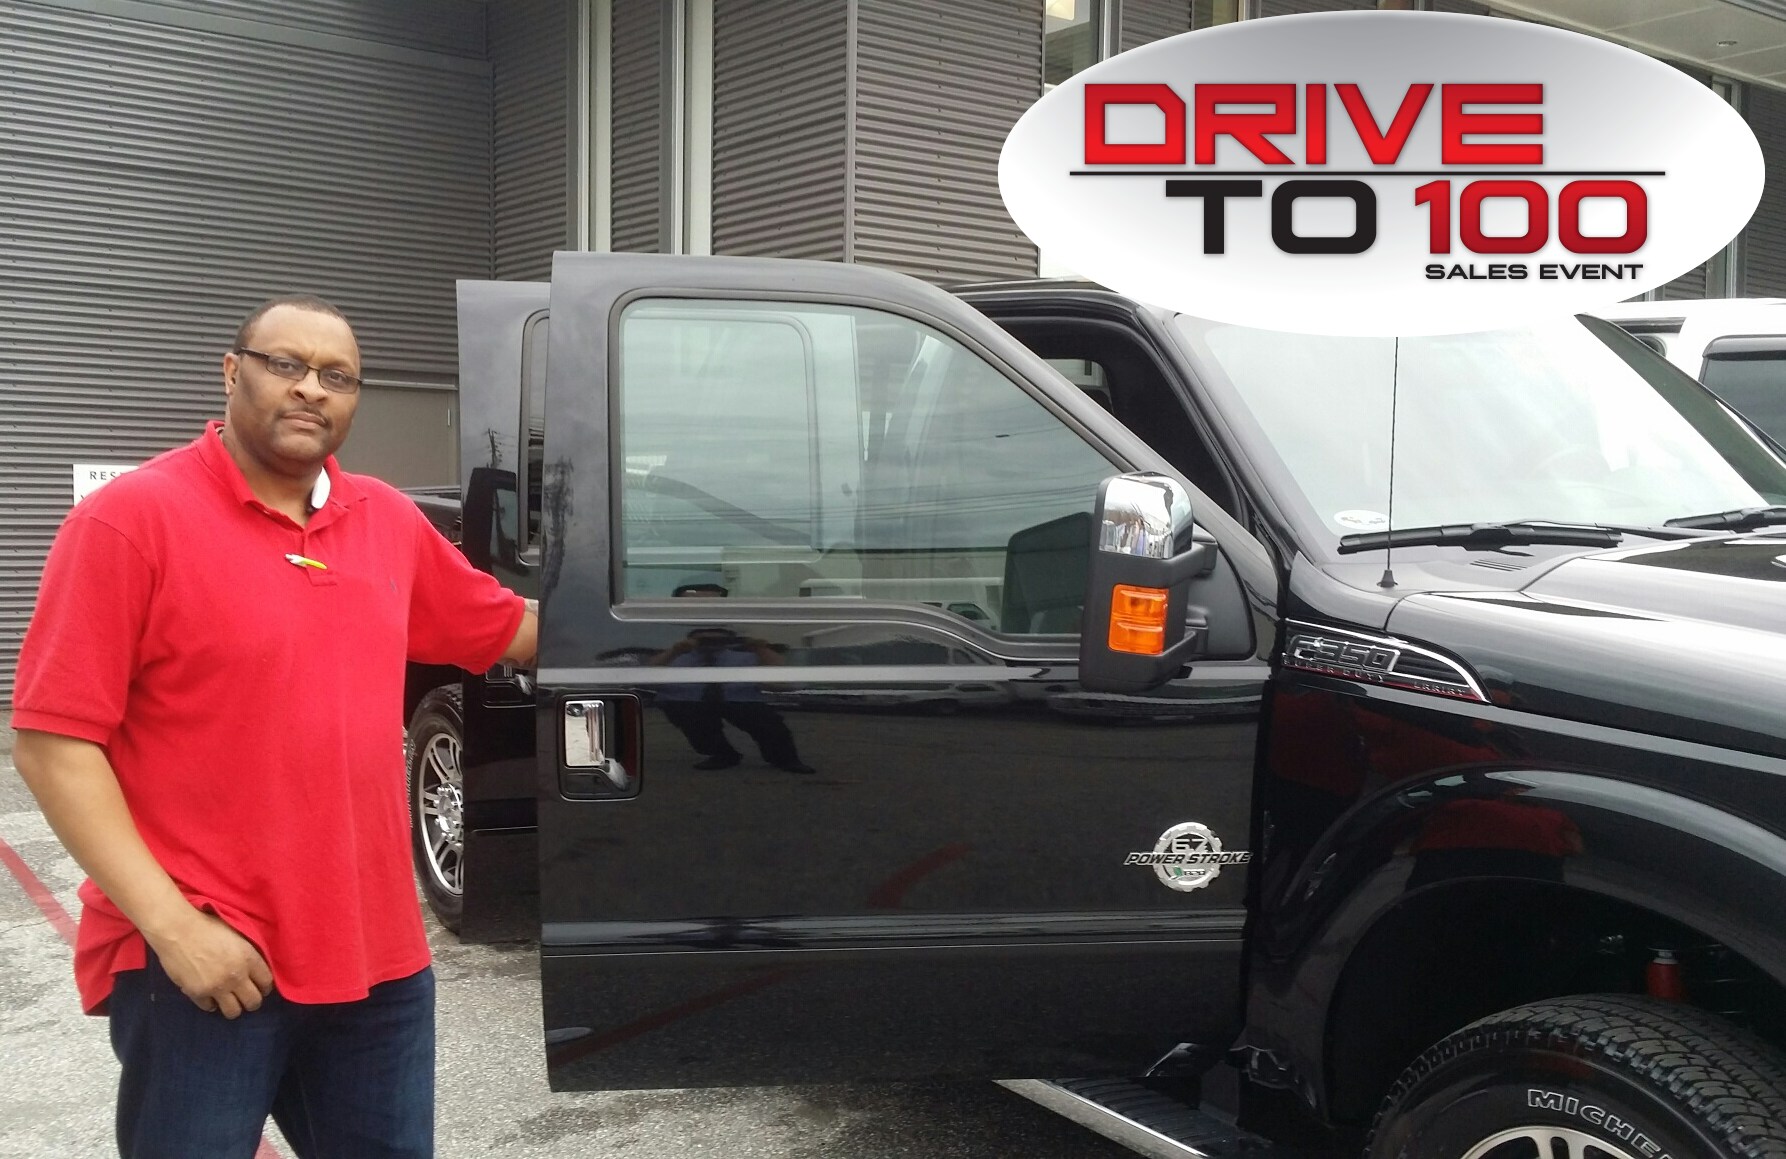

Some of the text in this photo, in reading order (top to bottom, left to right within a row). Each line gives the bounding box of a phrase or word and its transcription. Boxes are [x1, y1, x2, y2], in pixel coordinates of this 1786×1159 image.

[1123, 851, 1251, 865] POWER STROKE
[1528, 1089, 1671, 1159] MICHE
